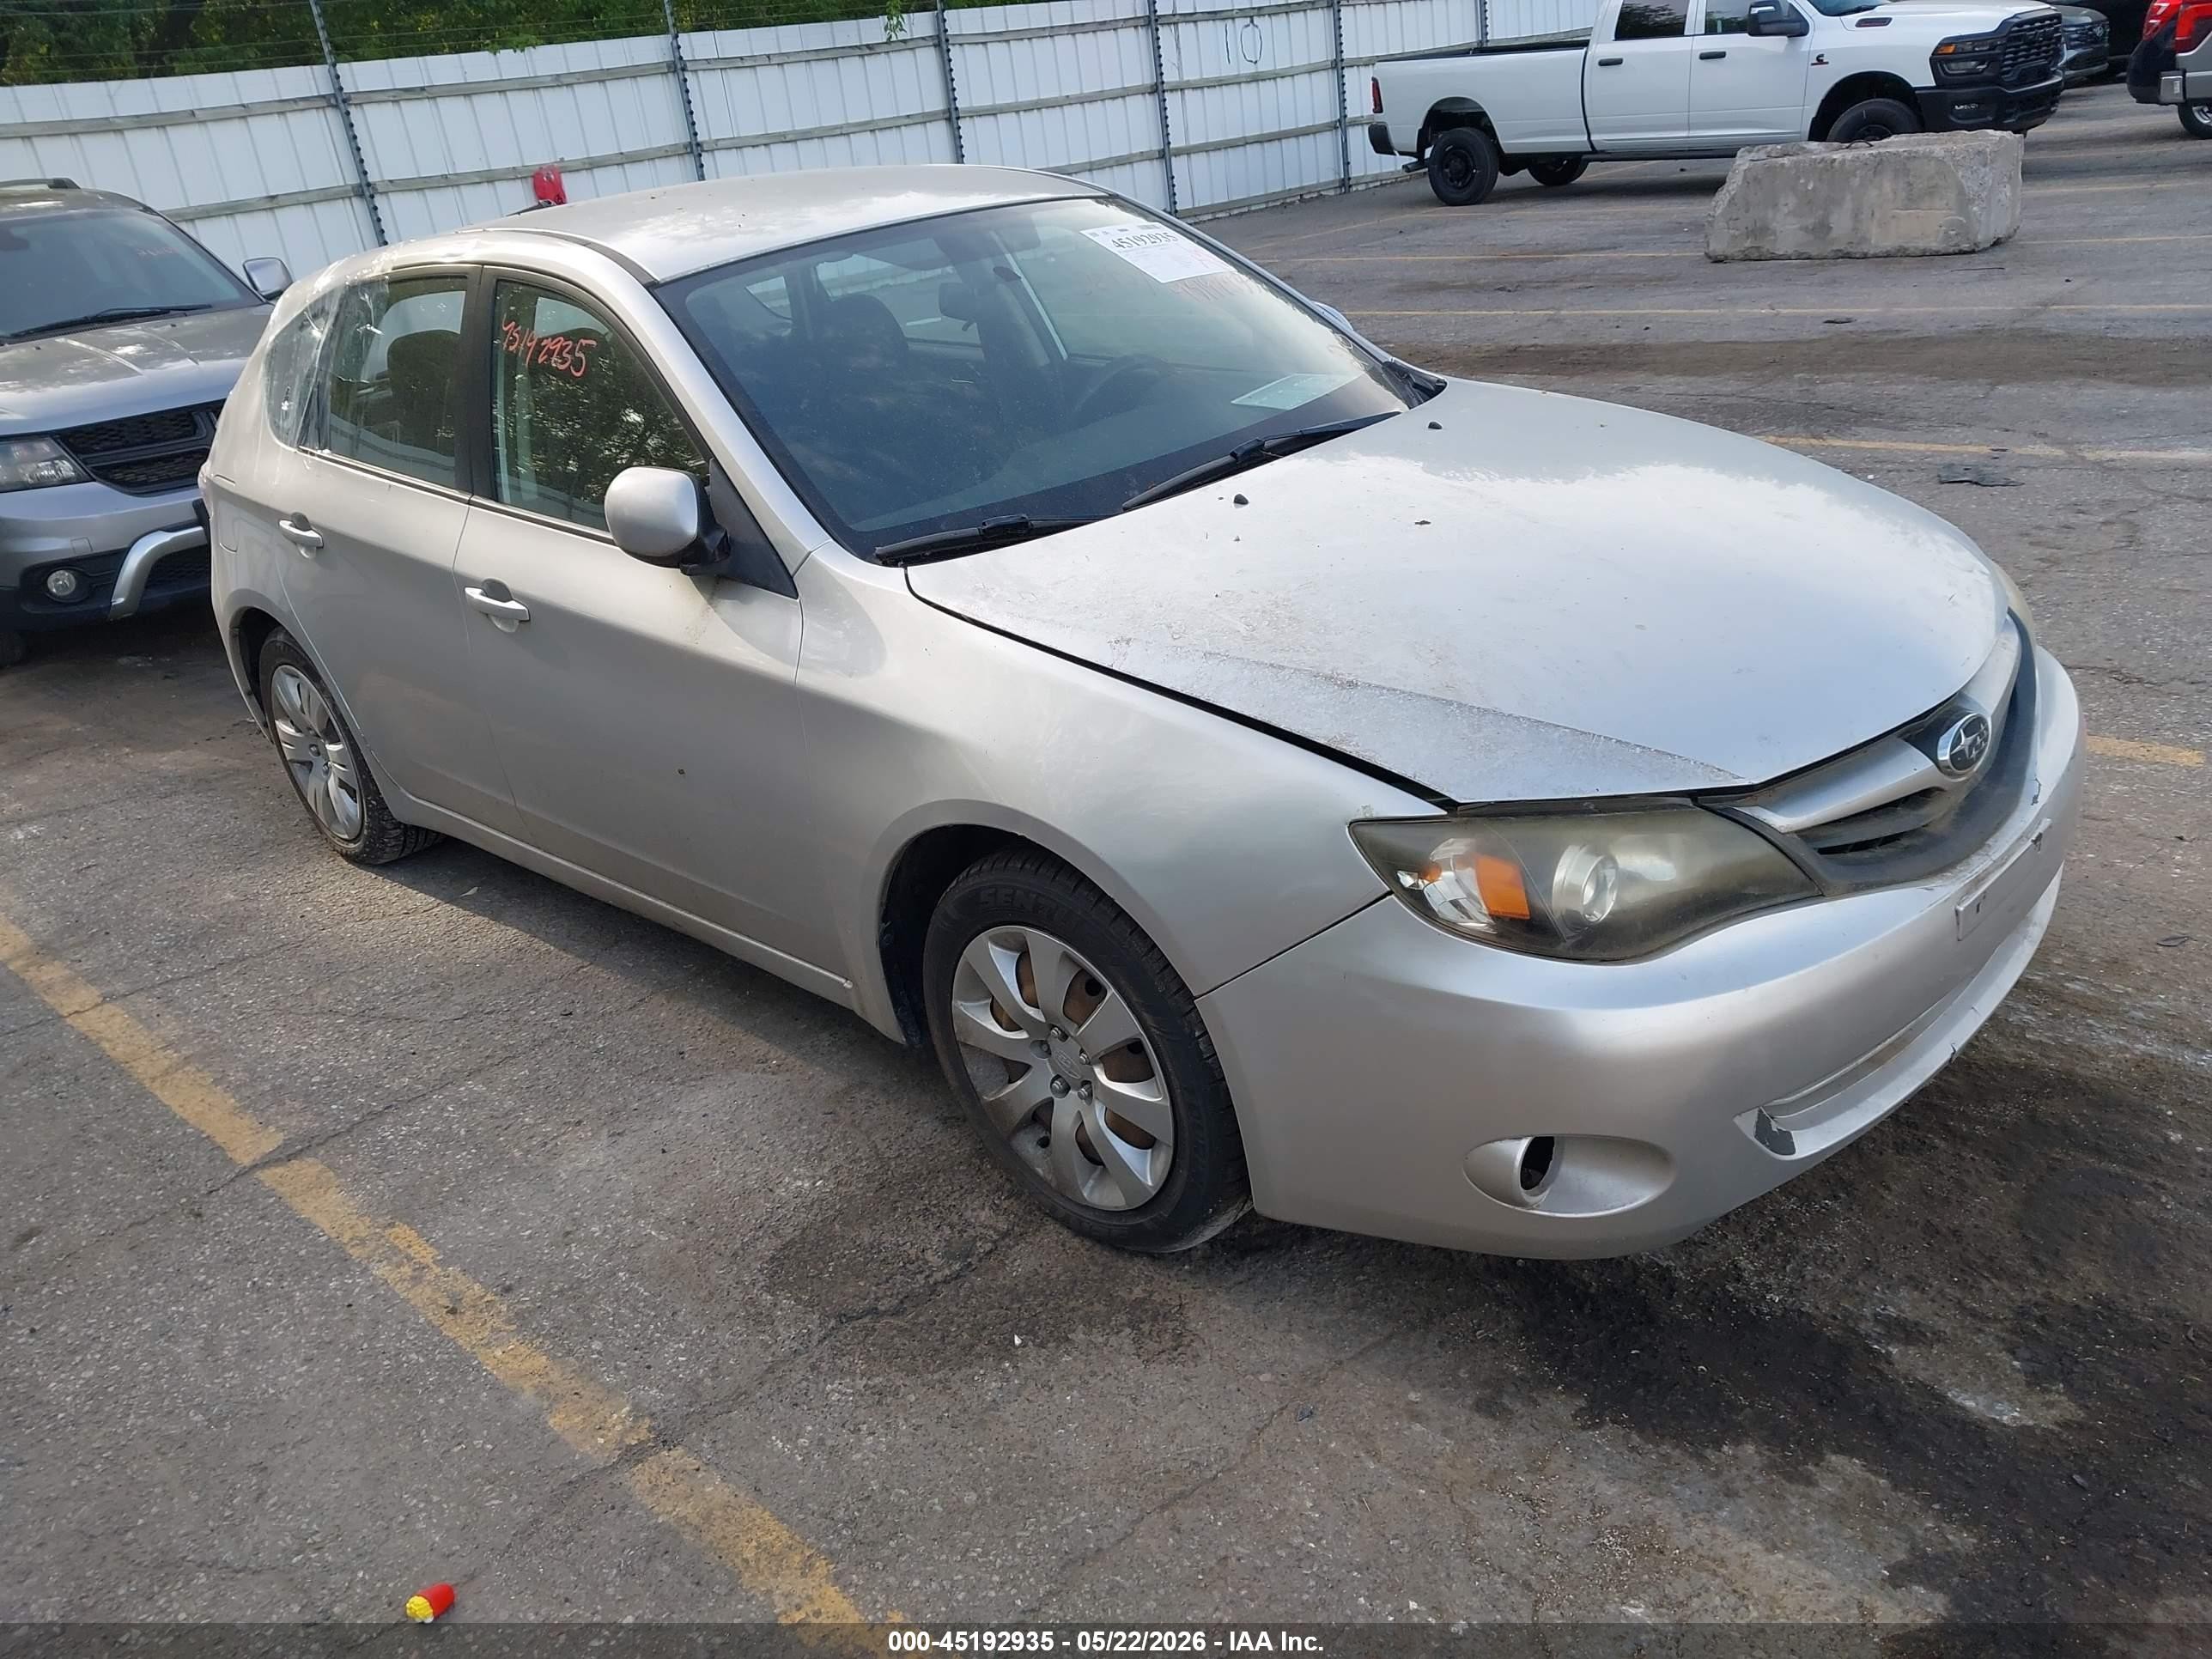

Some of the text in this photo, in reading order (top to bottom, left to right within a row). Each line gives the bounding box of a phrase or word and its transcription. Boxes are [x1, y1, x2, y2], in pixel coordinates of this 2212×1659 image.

[1224, 20, 1262, 65] 10
[1111, 232, 1179, 250] 45192935
[502, 313, 597, 377] 45192935
